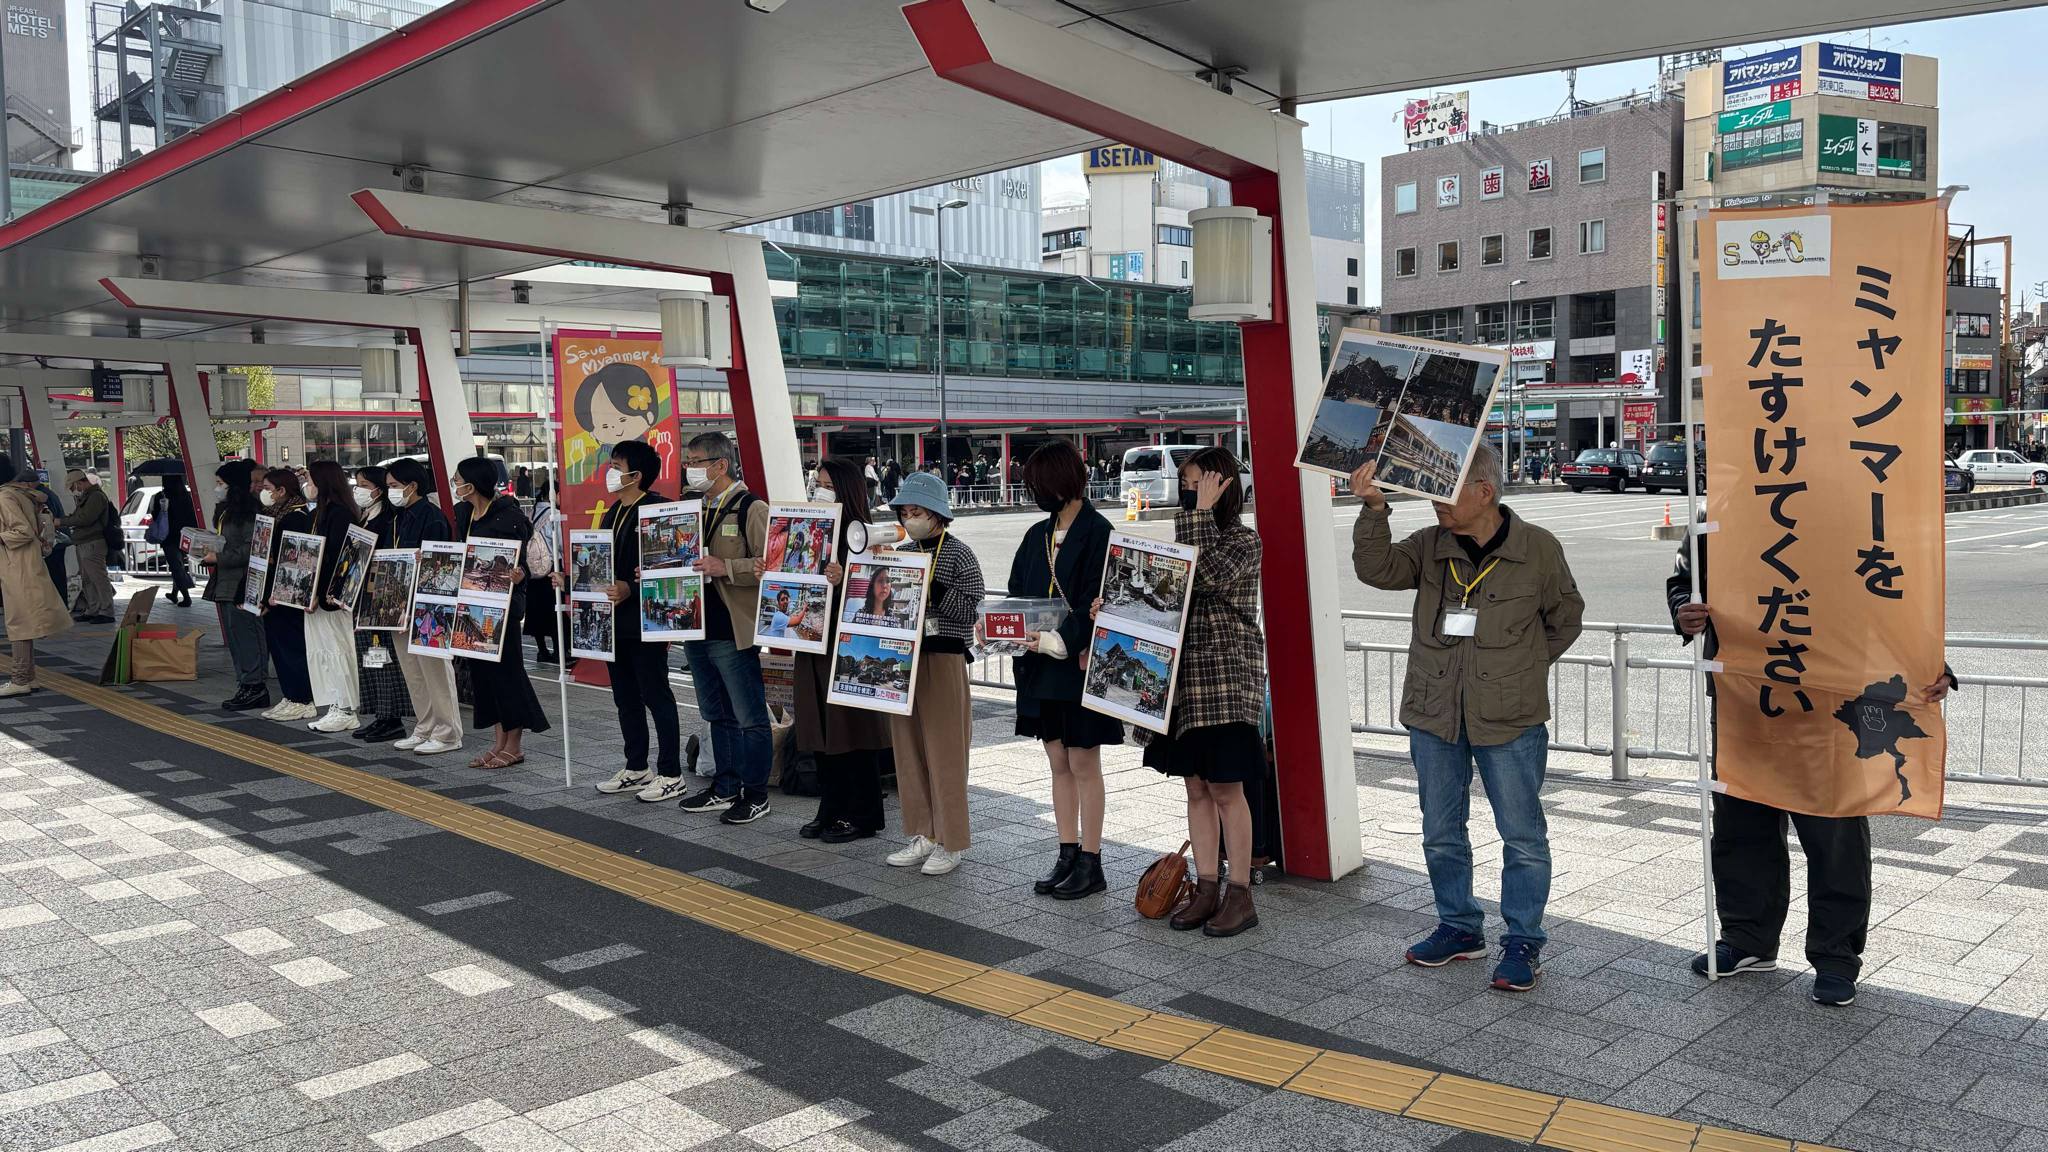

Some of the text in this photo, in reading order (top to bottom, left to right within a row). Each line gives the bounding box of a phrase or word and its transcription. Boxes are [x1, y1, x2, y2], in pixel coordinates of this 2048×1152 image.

[7, 5, 38, 15] JR-EAST
[7, 12, 57, 29] HOTEL
[8, 23, 47, 38] METS
[1729, 55, 1798, 81] アパマンショップ
[1833, 51, 1887, 72] アパマンショップ
[1407, 107, 1466, 138] はなの舞
[1734, 105, 1775, 129] エイブル
[1858, 122, 1869, 134] 5F
[1821, 136, 1855, 156] エイブル
[1089, 146, 1154, 168] ISETAN
[1484, 163, 1551, 195] 歯 科
[1439, 194, 1457, 205] トマト
[565, 344, 608, 364] Save
[1850, 265, 1905, 599] ミャンマーを
[1749, 318, 1813, 718] たすけてください
